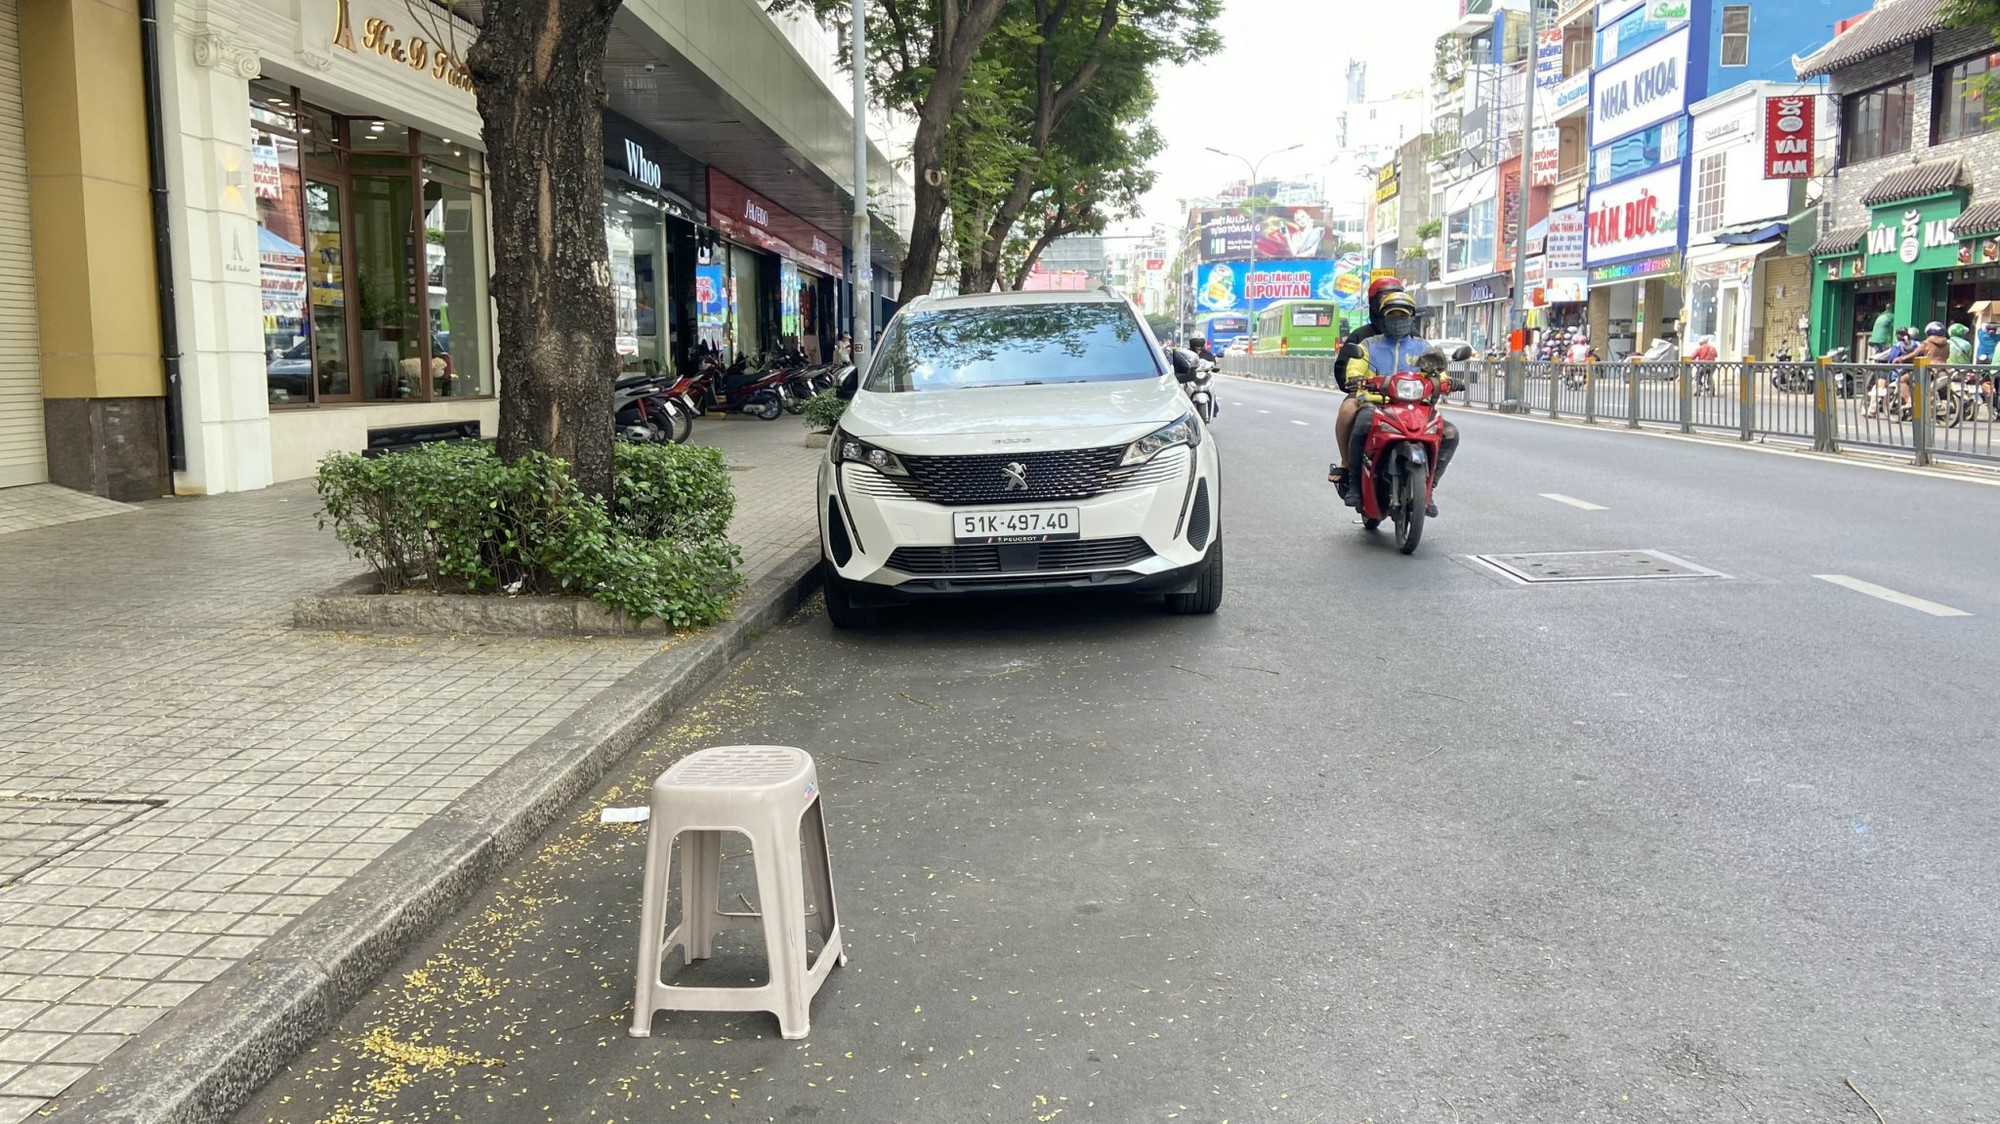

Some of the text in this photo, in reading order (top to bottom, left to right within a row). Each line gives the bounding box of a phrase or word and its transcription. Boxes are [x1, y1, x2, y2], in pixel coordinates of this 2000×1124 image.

[1600, 80, 1630, 122] NHA
[1633, 56, 1678, 107] KHOA
[1775, 135, 1807, 153] VÂN
[624, 138, 661, 189] Whoo
[1773, 160, 1807, 175] NAM
[1534, 173, 1557, 186] LAN
[1588, 200, 1621, 248] TÂM
[1624, 188, 1657, 239] ĐỨC
[1867, 222, 1897, 255] VÂN
[1246, 284, 1310, 297] LIPOVITAN
[964, 512, 1068, 533] 51K-497.40
